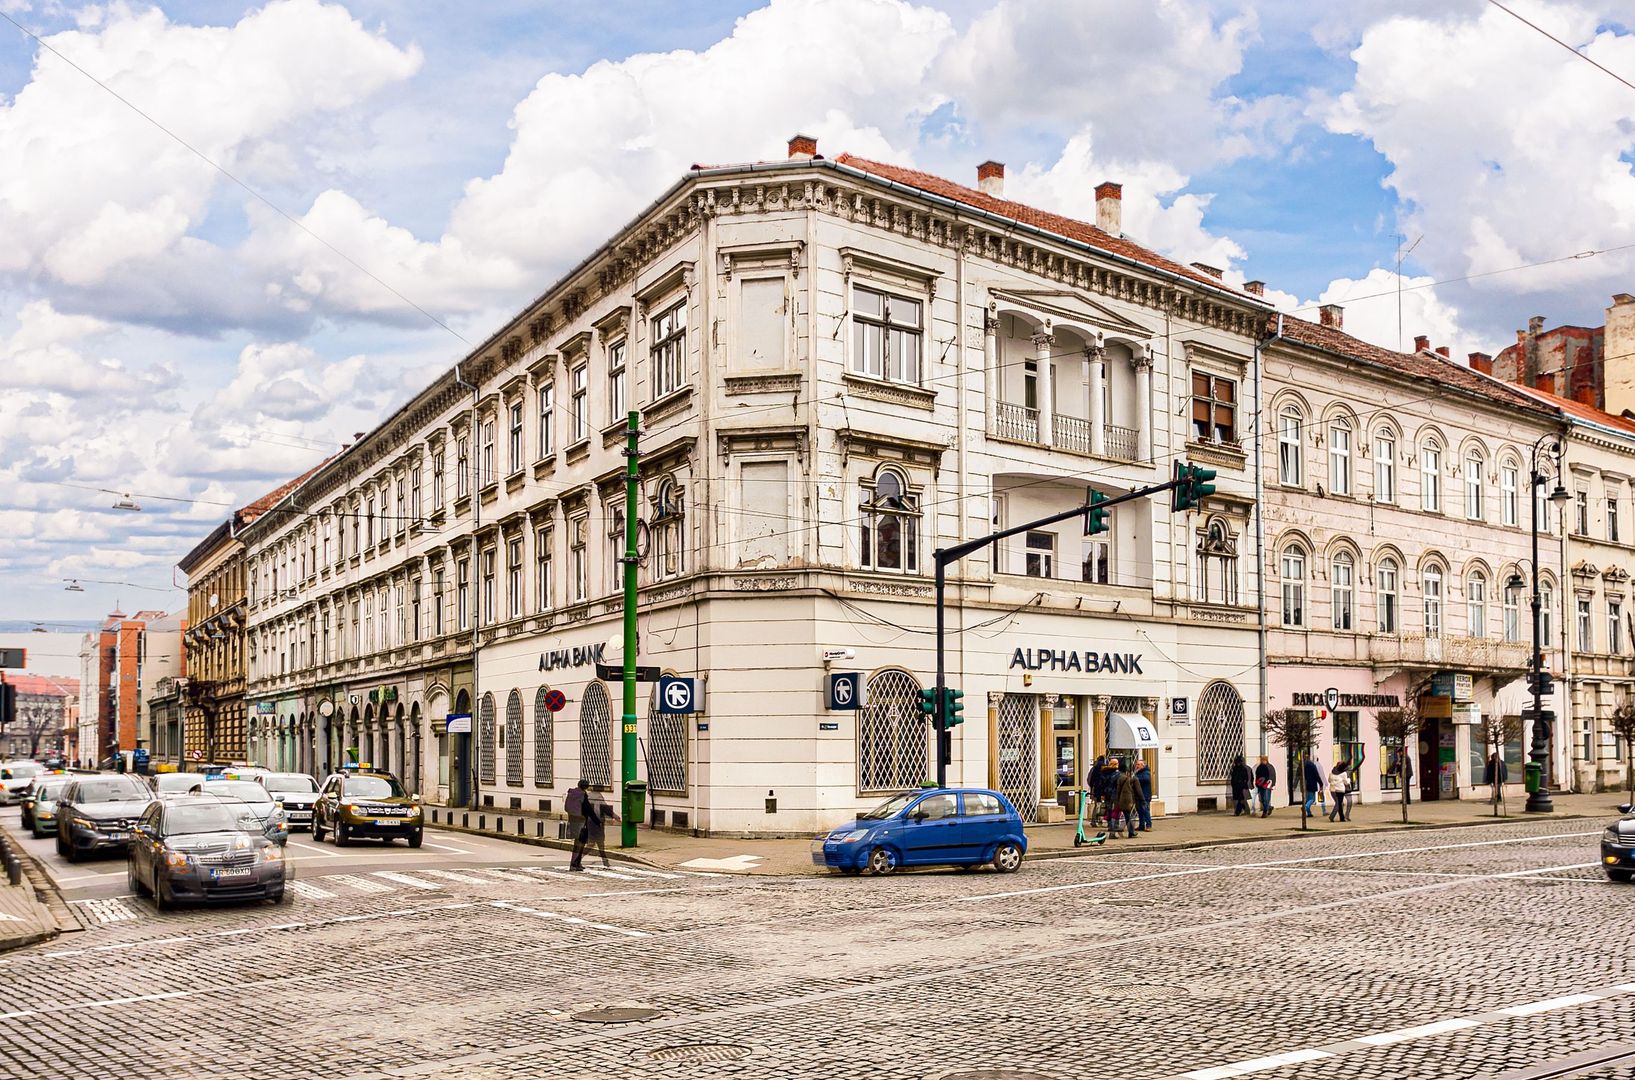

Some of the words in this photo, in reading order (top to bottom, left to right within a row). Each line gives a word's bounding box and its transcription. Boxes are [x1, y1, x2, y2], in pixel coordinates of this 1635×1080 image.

[538, 649, 572, 672] ALPHA
[573, 642, 607, 667] BANK
[1009, 647, 1081, 672] ALPHA
[1085, 651, 1143, 675] BANK
[1292, 692, 1324, 706] BANCA
[1339, 693, 1400, 708] TRANSILVANIA
